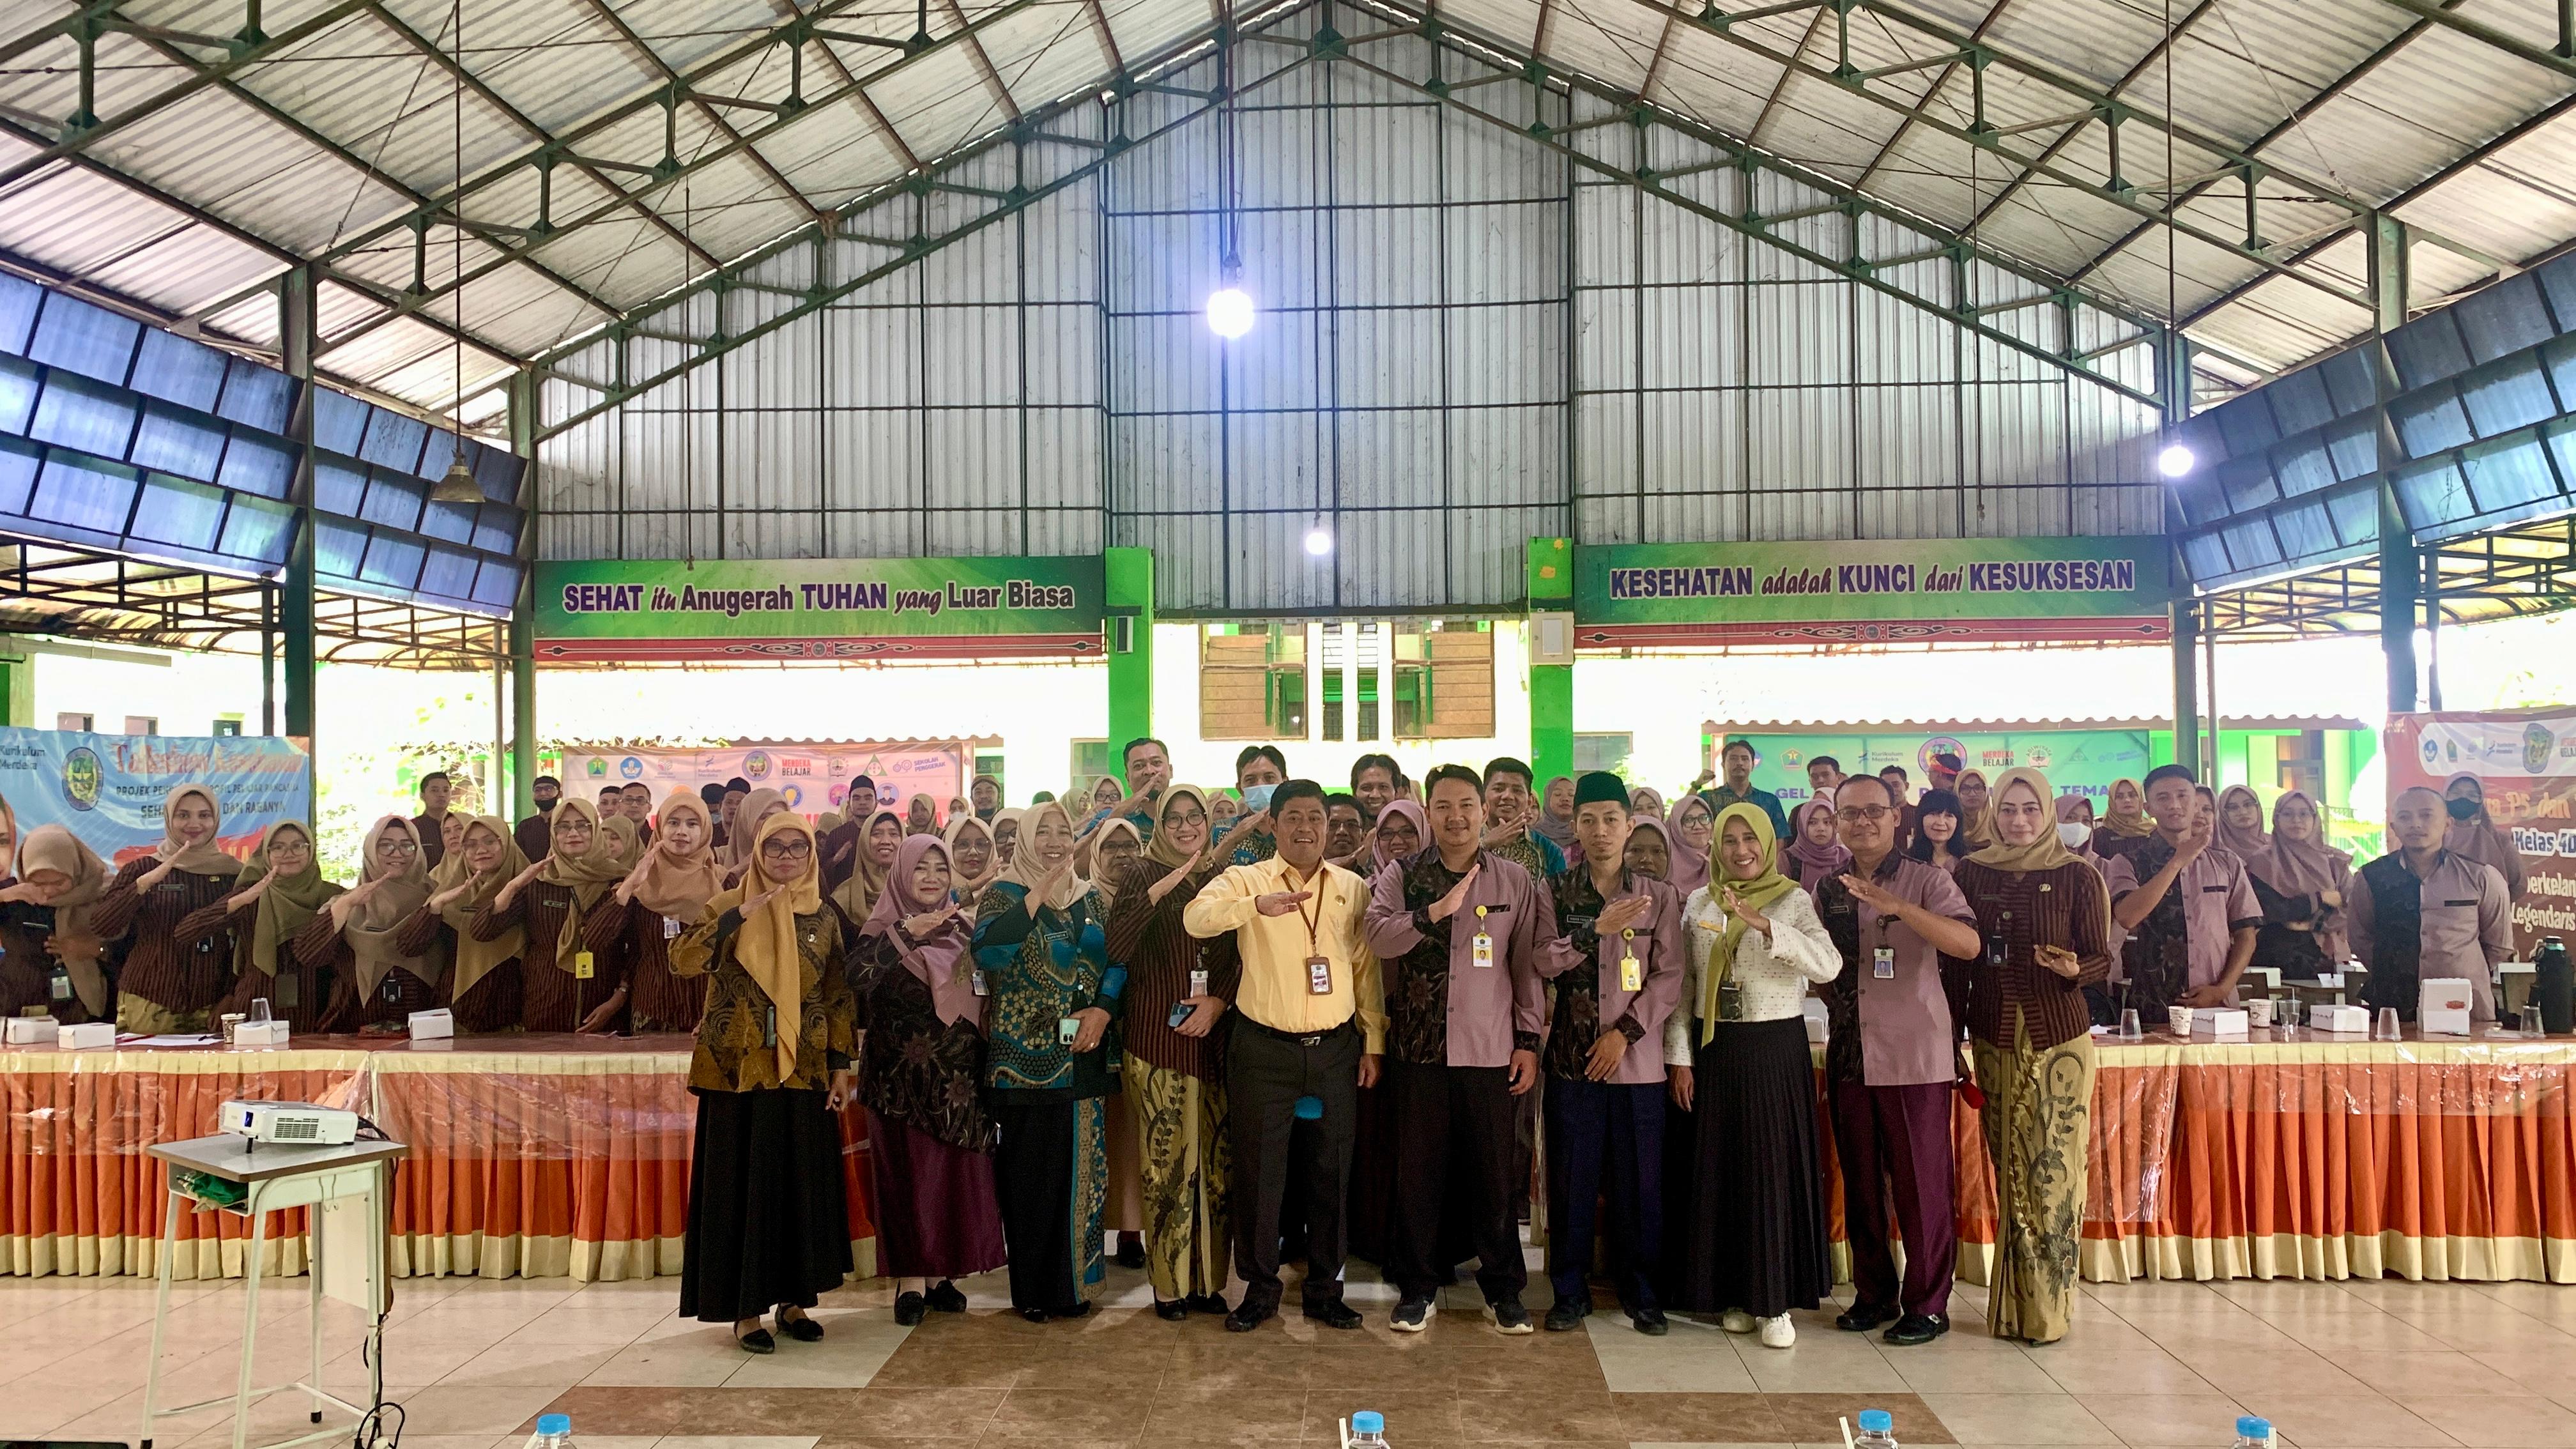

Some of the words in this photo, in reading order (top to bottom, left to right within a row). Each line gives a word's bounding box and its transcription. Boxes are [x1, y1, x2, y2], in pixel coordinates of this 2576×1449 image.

[1611, 567, 1752, 597] KESEHATAN
[1761, 567, 1832, 594] adalah
[1839, 564, 1915, 593] KUNCI
[1924, 564, 1963, 592] dari
[1970, 562, 2133, 592] KESUKSESAN
[564, 585, 643, 611] SEHAT
[650, 586, 677, 611] itu
[680, 585, 793, 617] Anugerah
[801, 583, 887, 610] TUHAN
[894, 590, 941, 615] yang
[948, 583, 1001, 608] Luar
[1008, 582, 1073, 608] Biasa
[0, 759, 37, 770] Merdea
[782, 759, 811, 767] MERDEKA
[782, 768, 811, 776] BELAJAR
[116, 786, 150, 796] PROJEK
[1775, 788, 1809, 799] GEL
[2060, 785, 2108, 796] TEMA
[223, 802, 243, 815] DAN
[245, 801, 286, 814] RAGANYA
[2505, 791, 2530, 818] P5
[2537, 792, 2572, 819] dan
[2514, 831, 2554, 852] Kelas
[2527, 871, 2576, 898] erkelan
[2511, 901, 2576, 933] Legendaris
